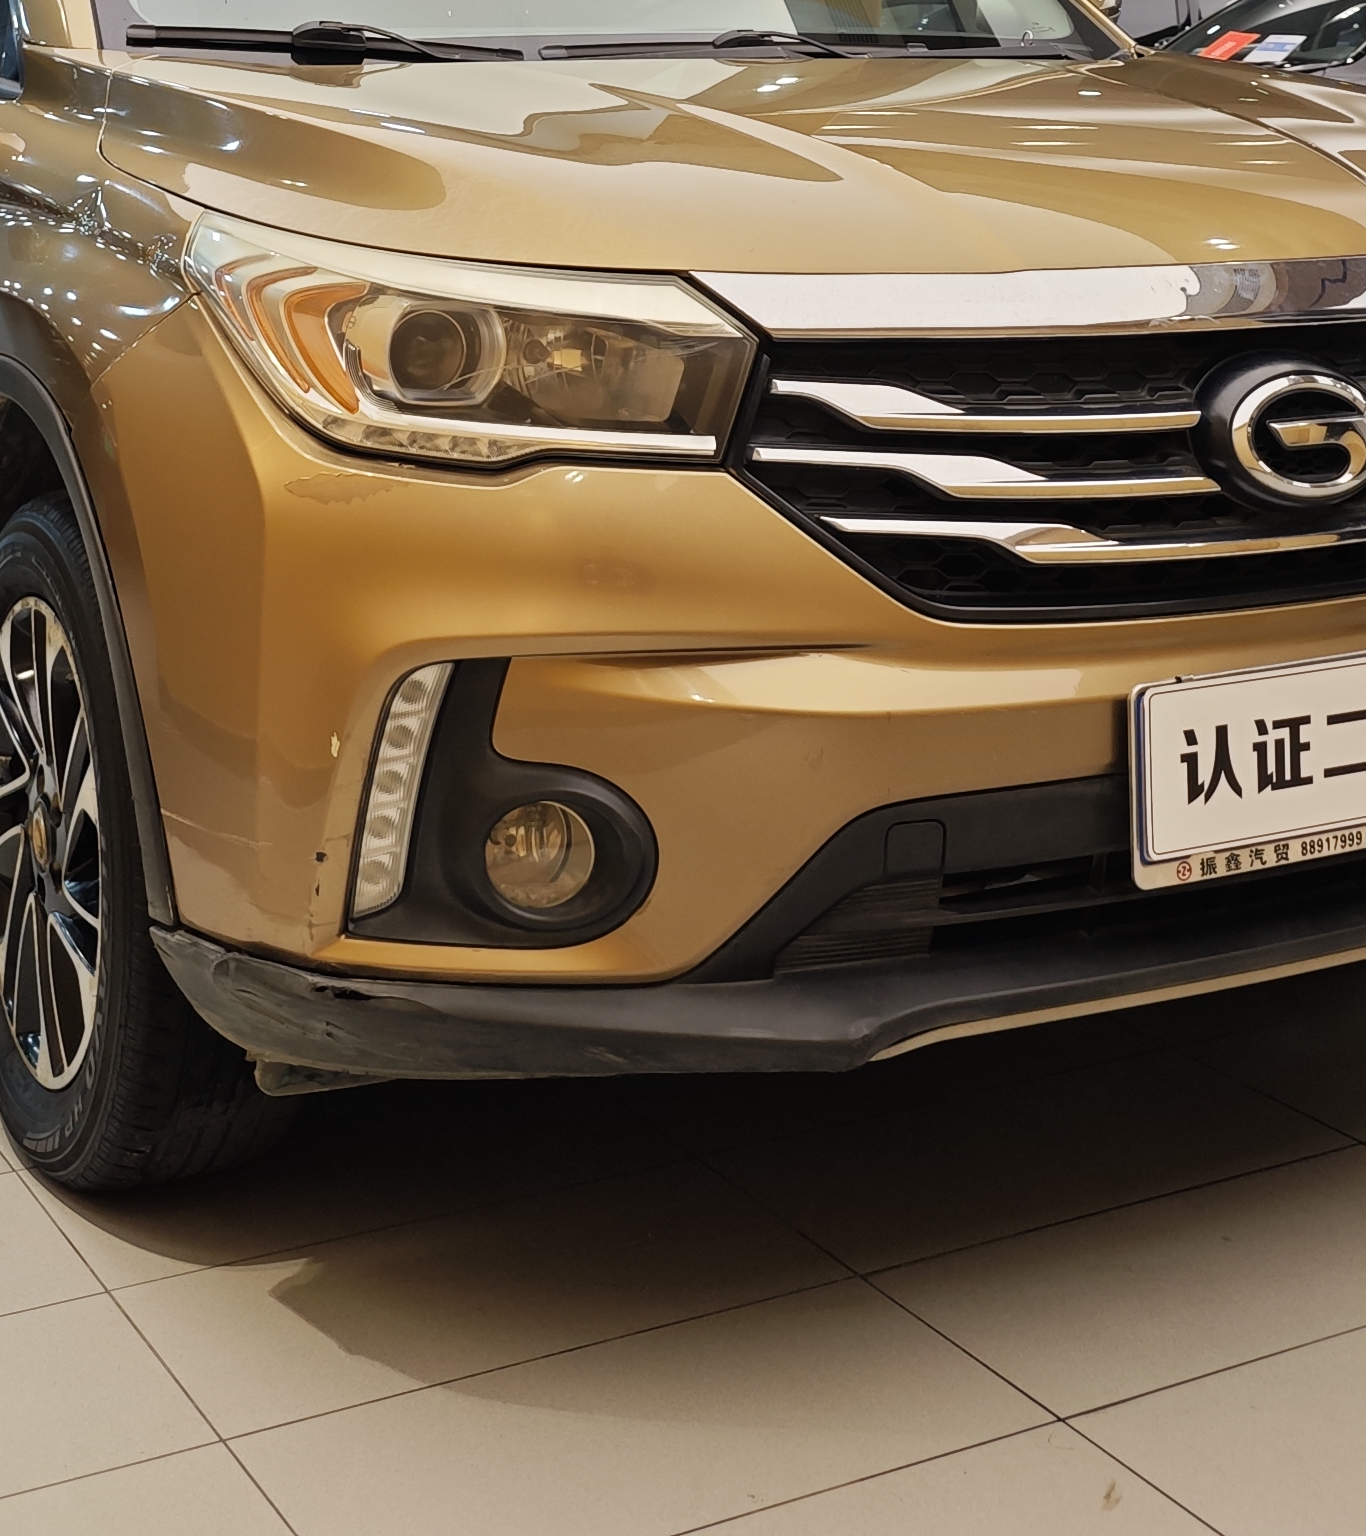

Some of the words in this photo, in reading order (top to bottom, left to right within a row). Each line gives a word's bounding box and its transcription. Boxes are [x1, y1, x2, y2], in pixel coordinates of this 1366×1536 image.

[1199, 842, 1290, 877] 振鑫汽贸
[1300, 831, 1363, 857] 88917999
